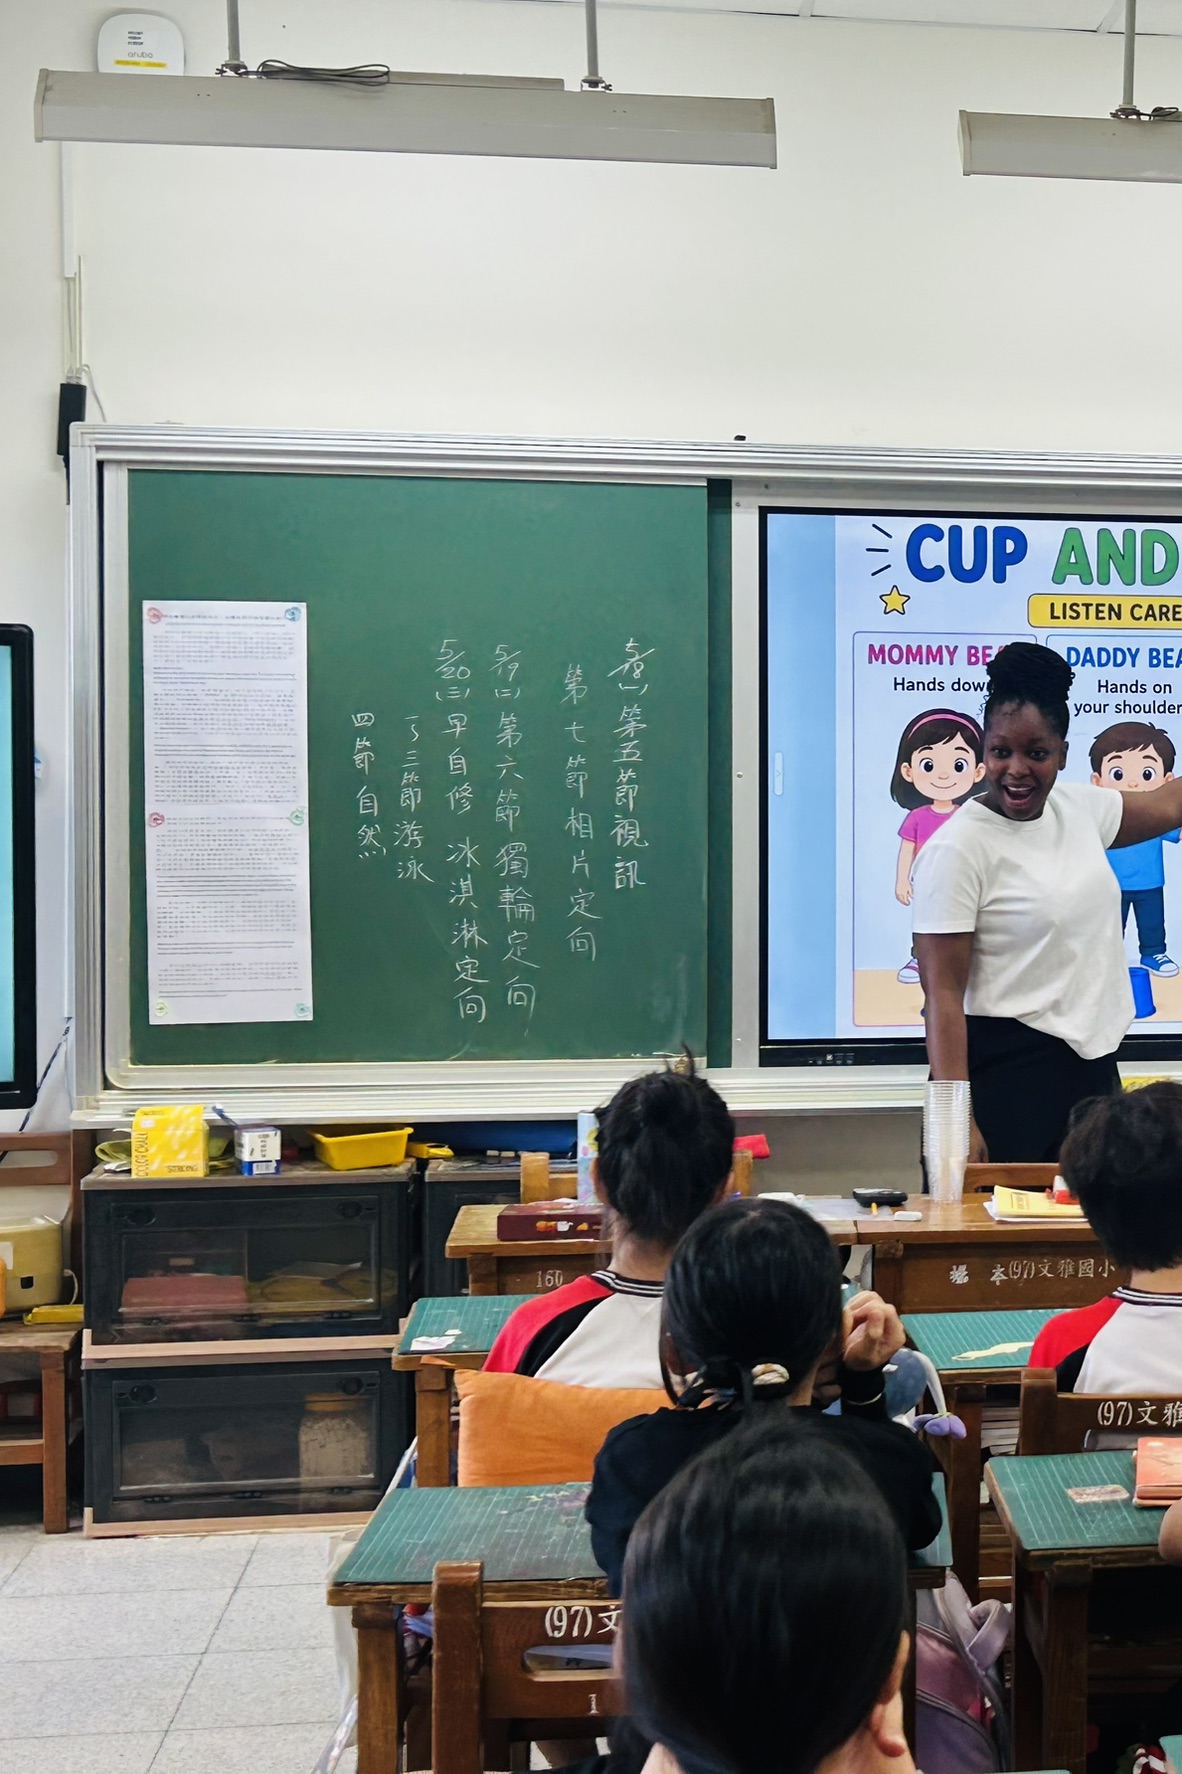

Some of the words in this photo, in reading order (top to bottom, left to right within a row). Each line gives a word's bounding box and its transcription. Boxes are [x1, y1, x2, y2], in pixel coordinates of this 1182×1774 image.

[906, 524, 1028, 584] CUP
[1052, 527, 1179, 588] AND
[1050, 602, 1122, 621] LISTEN
[868, 644, 958, 666] MOMMY
[1066, 647, 1140, 668] DADDY
[893, 677, 945, 692] Hands
[951, 677, 989, 692] dow
[1097, 679, 1147, 694] Hands
[1153, 684, 1172, 694] on
[1074, 703, 1110, 717] your
[536, 1270, 564, 1288] 160
